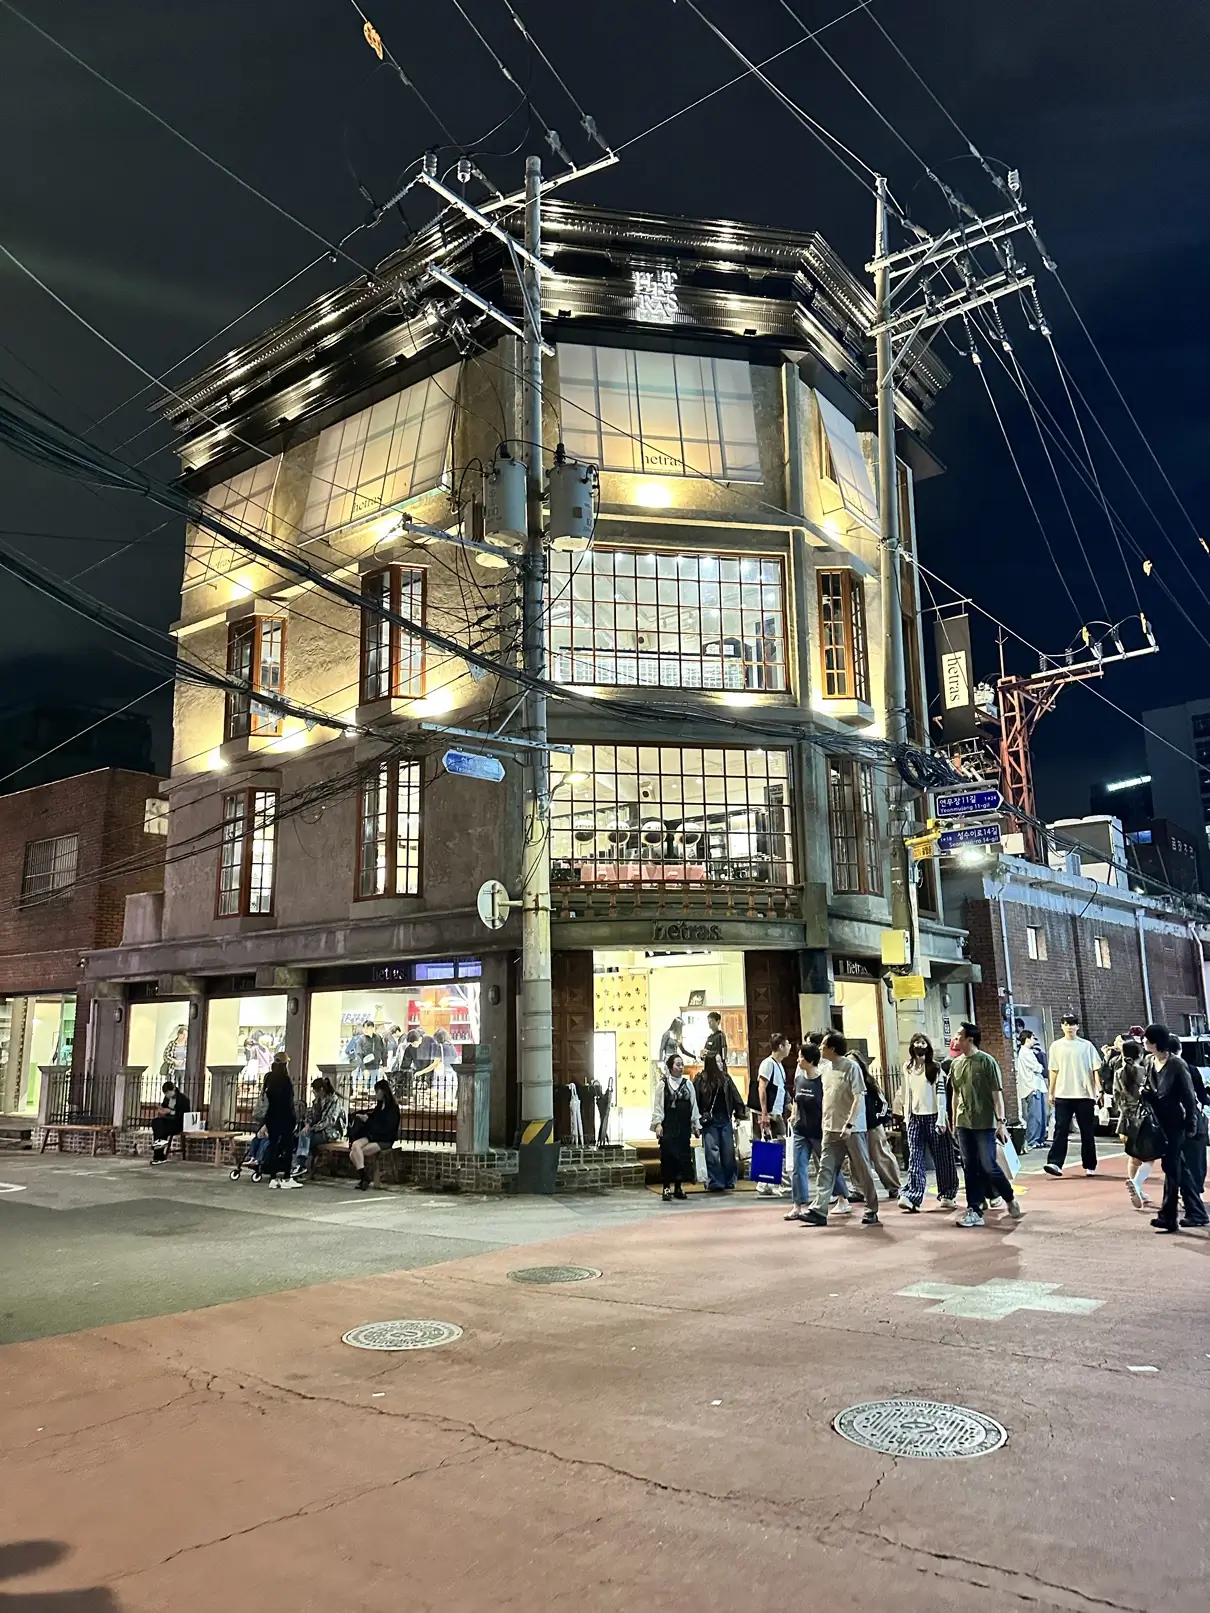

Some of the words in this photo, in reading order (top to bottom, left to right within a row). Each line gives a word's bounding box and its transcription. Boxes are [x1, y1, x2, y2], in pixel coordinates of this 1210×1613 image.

[939, 795, 976, 807] 연무장11길
[940, 805, 974, 814] Yeonmujang
[957, 827, 998, 841] 성수이로14길
